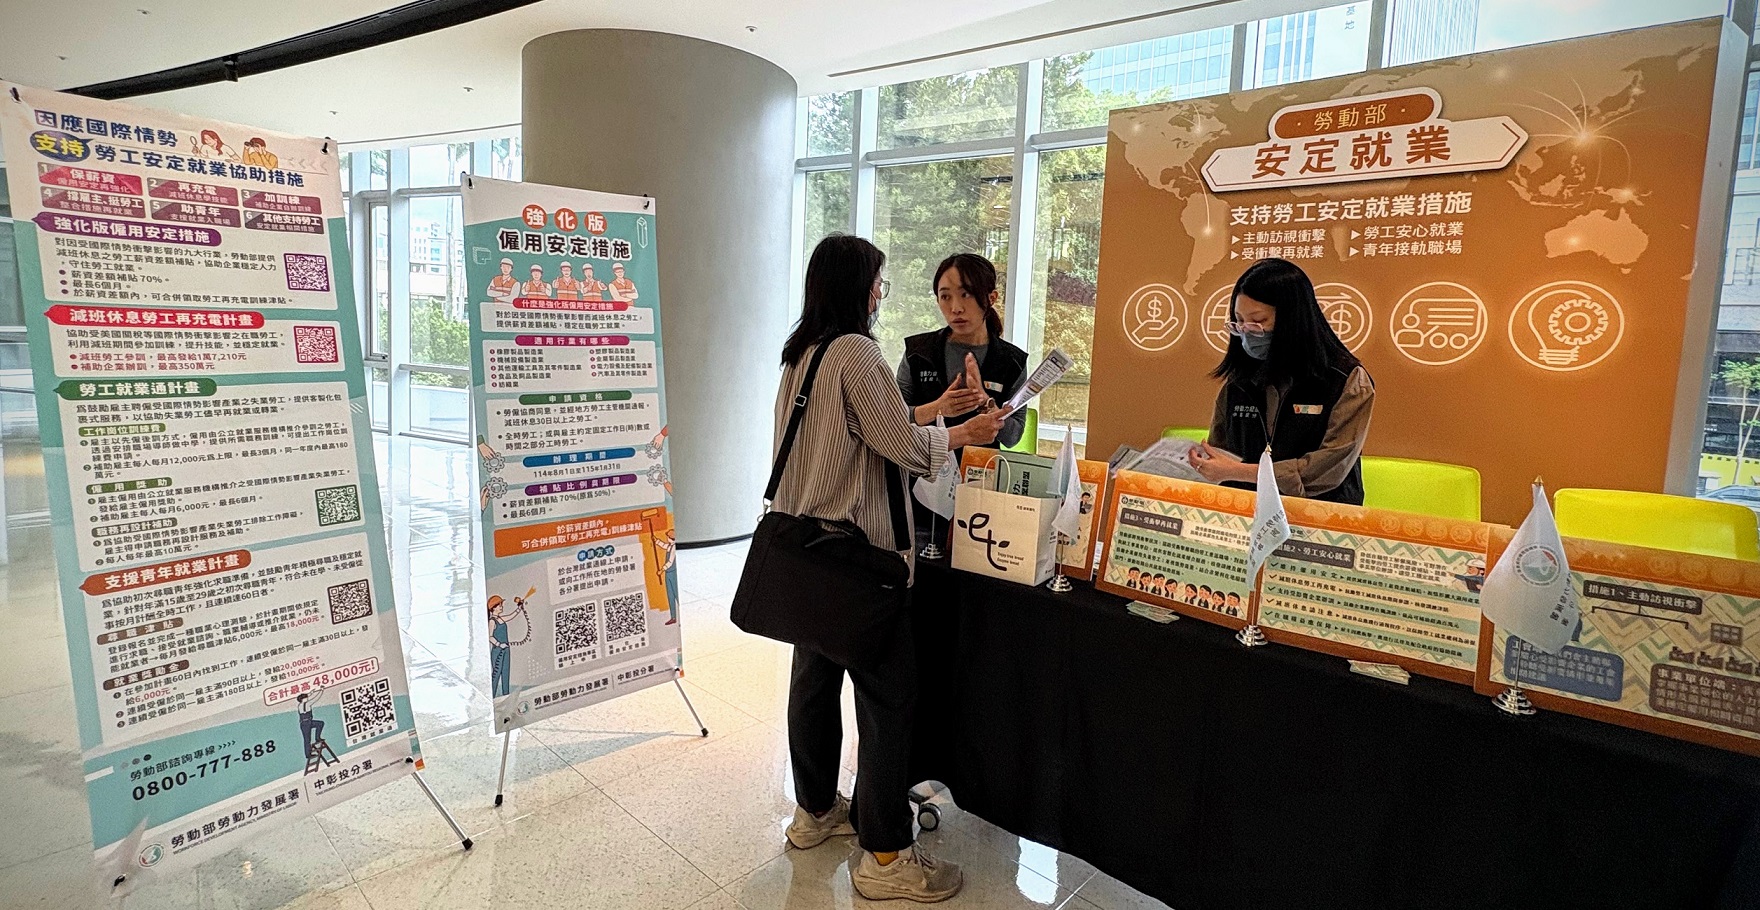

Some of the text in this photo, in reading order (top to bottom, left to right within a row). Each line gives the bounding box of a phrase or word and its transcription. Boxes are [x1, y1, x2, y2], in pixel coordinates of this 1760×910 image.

[1314, 104, 1388, 131] 勞動部
[34, 109, 178, 147] 因應國際情勢
[36, 133, 304, 188] 支持 勞工安定就業協助措施
[1252, 125, 1451, 180] 安定就業
[41, 164, 47, 173] 1
[70, 168, 115, 184] 保薪資
[150, 178, 158, 187] 2
[178, 181, 217, 196] 再充電
[44, 188, 52, 197] 4
[243, 190, 250, 199] 3
[264, 193, 301, 205] 加訓練
[153, 201, 160, 210] 5
[180, 204, 221, 217] 助青年
[1229, 191, 1473, 226] 支持勞工安定就業措施
[246, 212, 253, 220] 6
[262, 213, 321, 227] 其他支持勞工
[526, 206, 606, 232] 強化版
[53, 216, 211, 243] 強化版僱用安定措施
[1242, 222, 1465, 245] 主動訪視衝擊 勞工安心就業
[499, 230, 631, 259] 僱用安定措施
[1241, 240, 1463, 260] 受衝擊再就業 青年接軌職場
[521, 300, 614, 312] 什麼是強化版僱用安定措施
[69, 308, 253, 326] 減班休息勞工再充電計畫
[534, 336, 611, 345] 適用行業有哪些
[79, 381, 200, 397] 勞工就業通計畫
[548, 392, 603, 403] 申請資格
[83, 424, 161, 436] 工作崗位訓練費
[553, 451, 606, 464] 辦理期間
[533, 463, 621, 478] 114年8月1日至115年1月31日
[91, 478, 168, 494] 僱用獎助
[539, 476, 620, 493] 補貼比例與期限
[96, 519, 173, 536] 職務再設計補助
[578, 547, 614, 560] 申請方式
[104, 553, 240, 590] 支援青年就業計畫
[1588, 583, 1698, 610] 措施1、主動訪視衝擊
[268, 660, 375, 702] 合計最高 48,000元!
[617, 665, 655, 681] 中彰投分署
[534, 678, 609, 706] 勞動部勞動力發展署
[130, 746, 215, 781] 勞動部諮詢專線
[132, 740, 277, 801] 0800-777-888
[313, 759, 373, 789] 中彰投分署
[171, 788, 300, 849] 勞動部勞動力發展署
